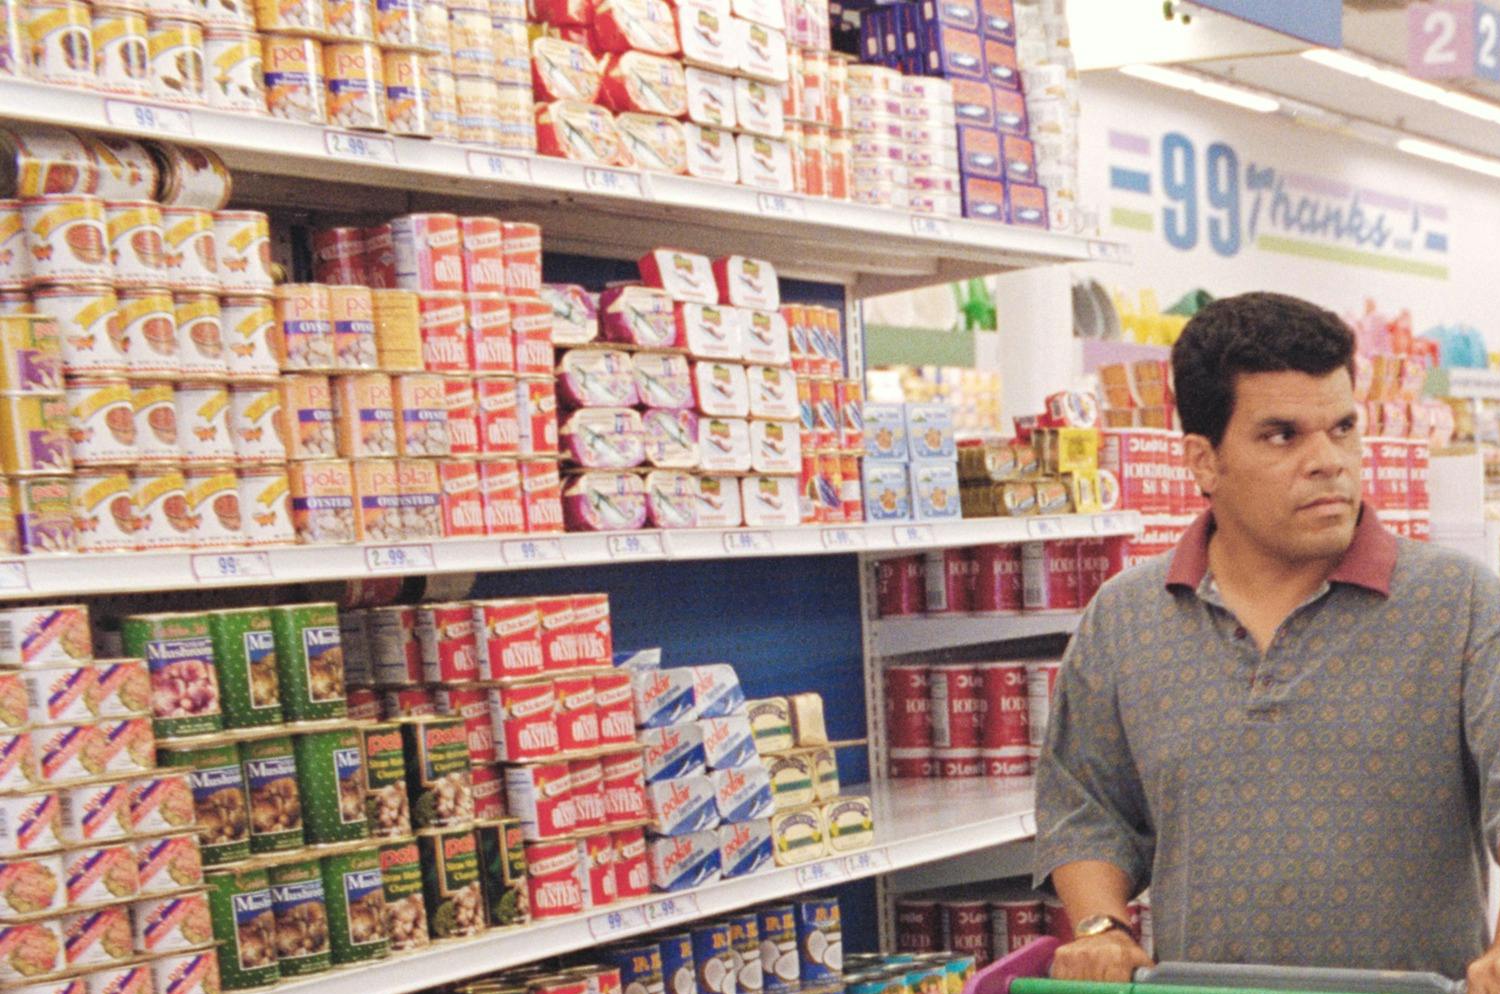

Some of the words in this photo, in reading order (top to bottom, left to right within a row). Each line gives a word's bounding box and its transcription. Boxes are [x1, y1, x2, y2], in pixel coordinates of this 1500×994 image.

[1423, 11, 1457, 65] 2
[1478, 13, 1498, 68] 2
[1161, 131, 1241, 257] 99
